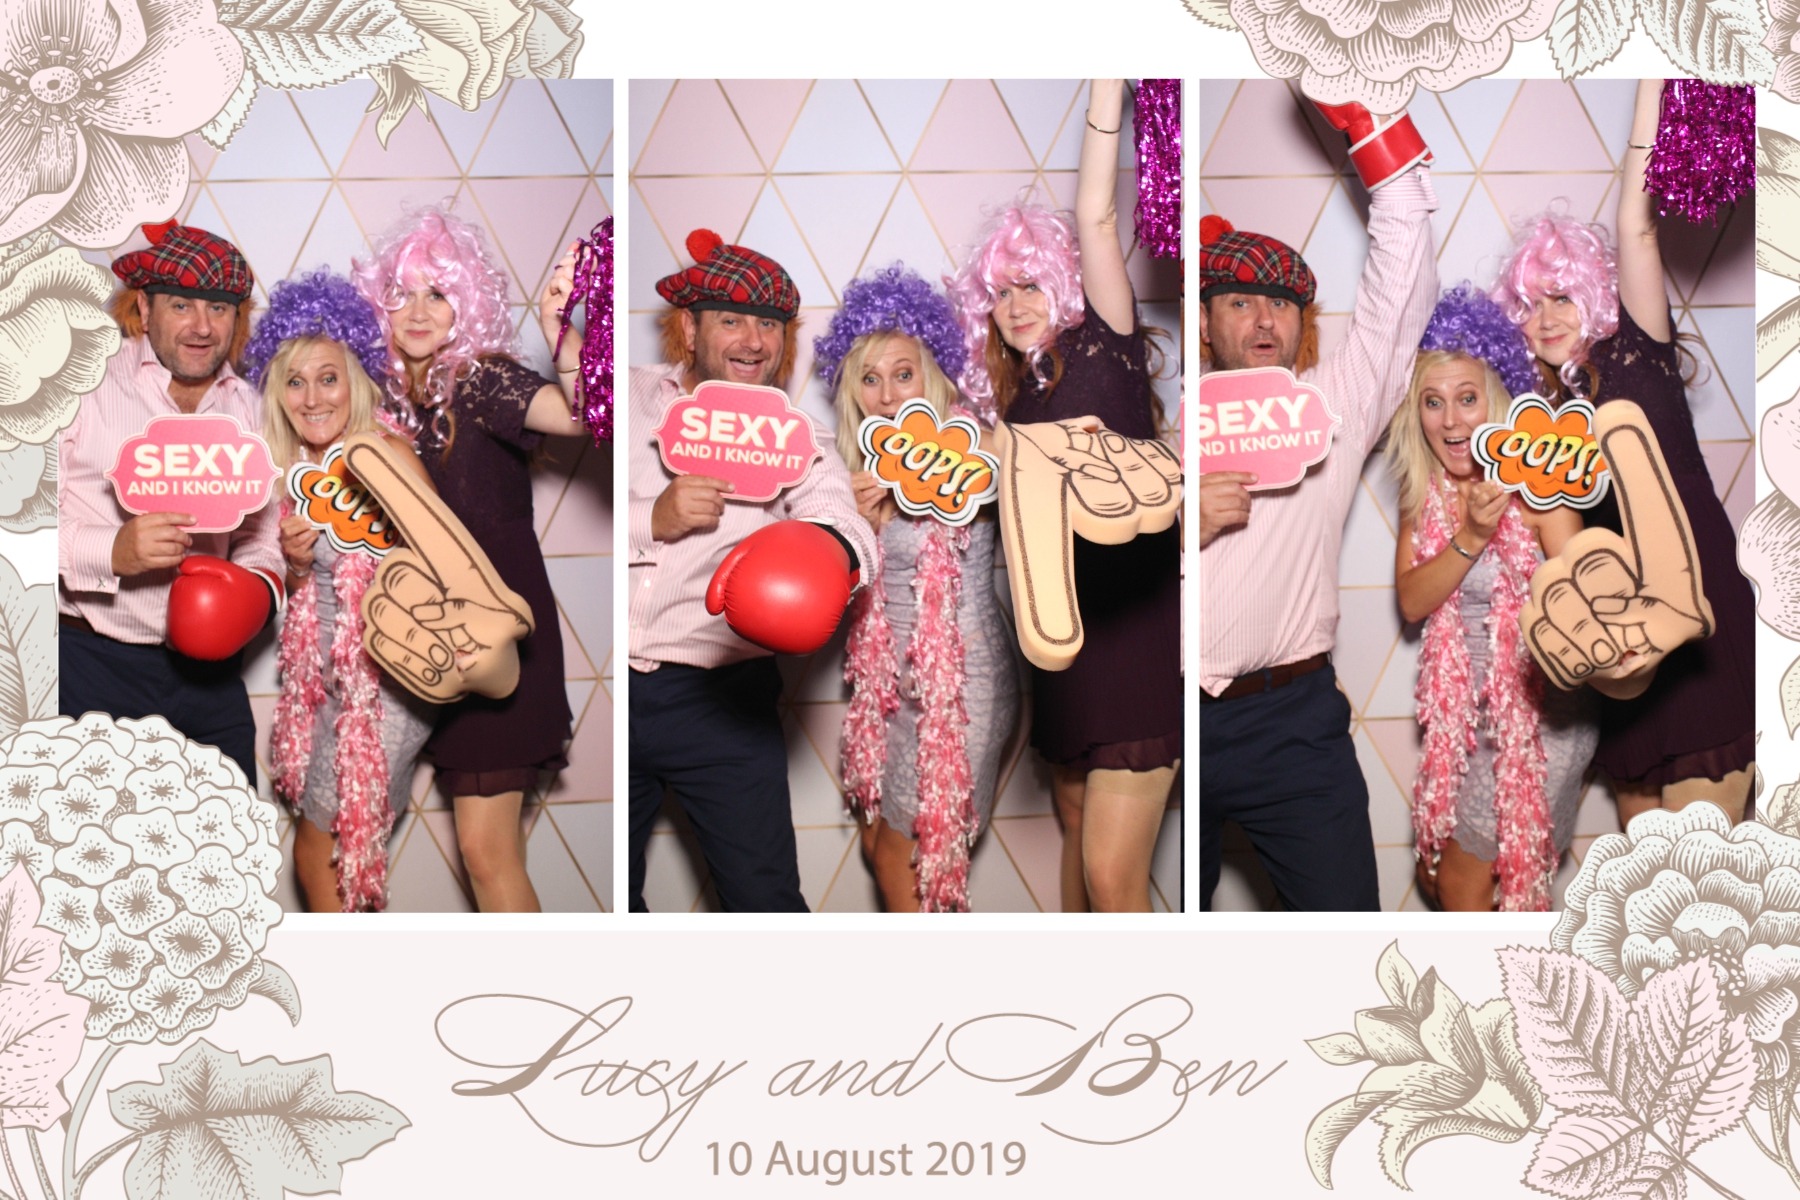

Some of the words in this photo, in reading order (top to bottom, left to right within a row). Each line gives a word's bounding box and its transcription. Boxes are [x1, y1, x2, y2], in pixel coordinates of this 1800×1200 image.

[680, 407, 800, 450] SEXY
[1199, 393, 1310, 440] SEXY
[134, 443, 255, 477] SEXY
[670, 441, 712, 459] AND
[715, 447, 721, 461] I
[725, 448, 783, 467] KNOW
[786, 454, 804, 470] IT
[1199, 440, 1226, 457] ND
[1229, 439, 1235, 454] I
[1239, 432, 1301, 453] KNOW
[1304, 429, 1322, 446] IT
[881, 431, 994, 507] OOPS!
[126, 480, 169, 496] AND
[173, 480, 179, 495] I
[182, 480, 242, 495] KNOW
[245, 479, 263, 495] IT
